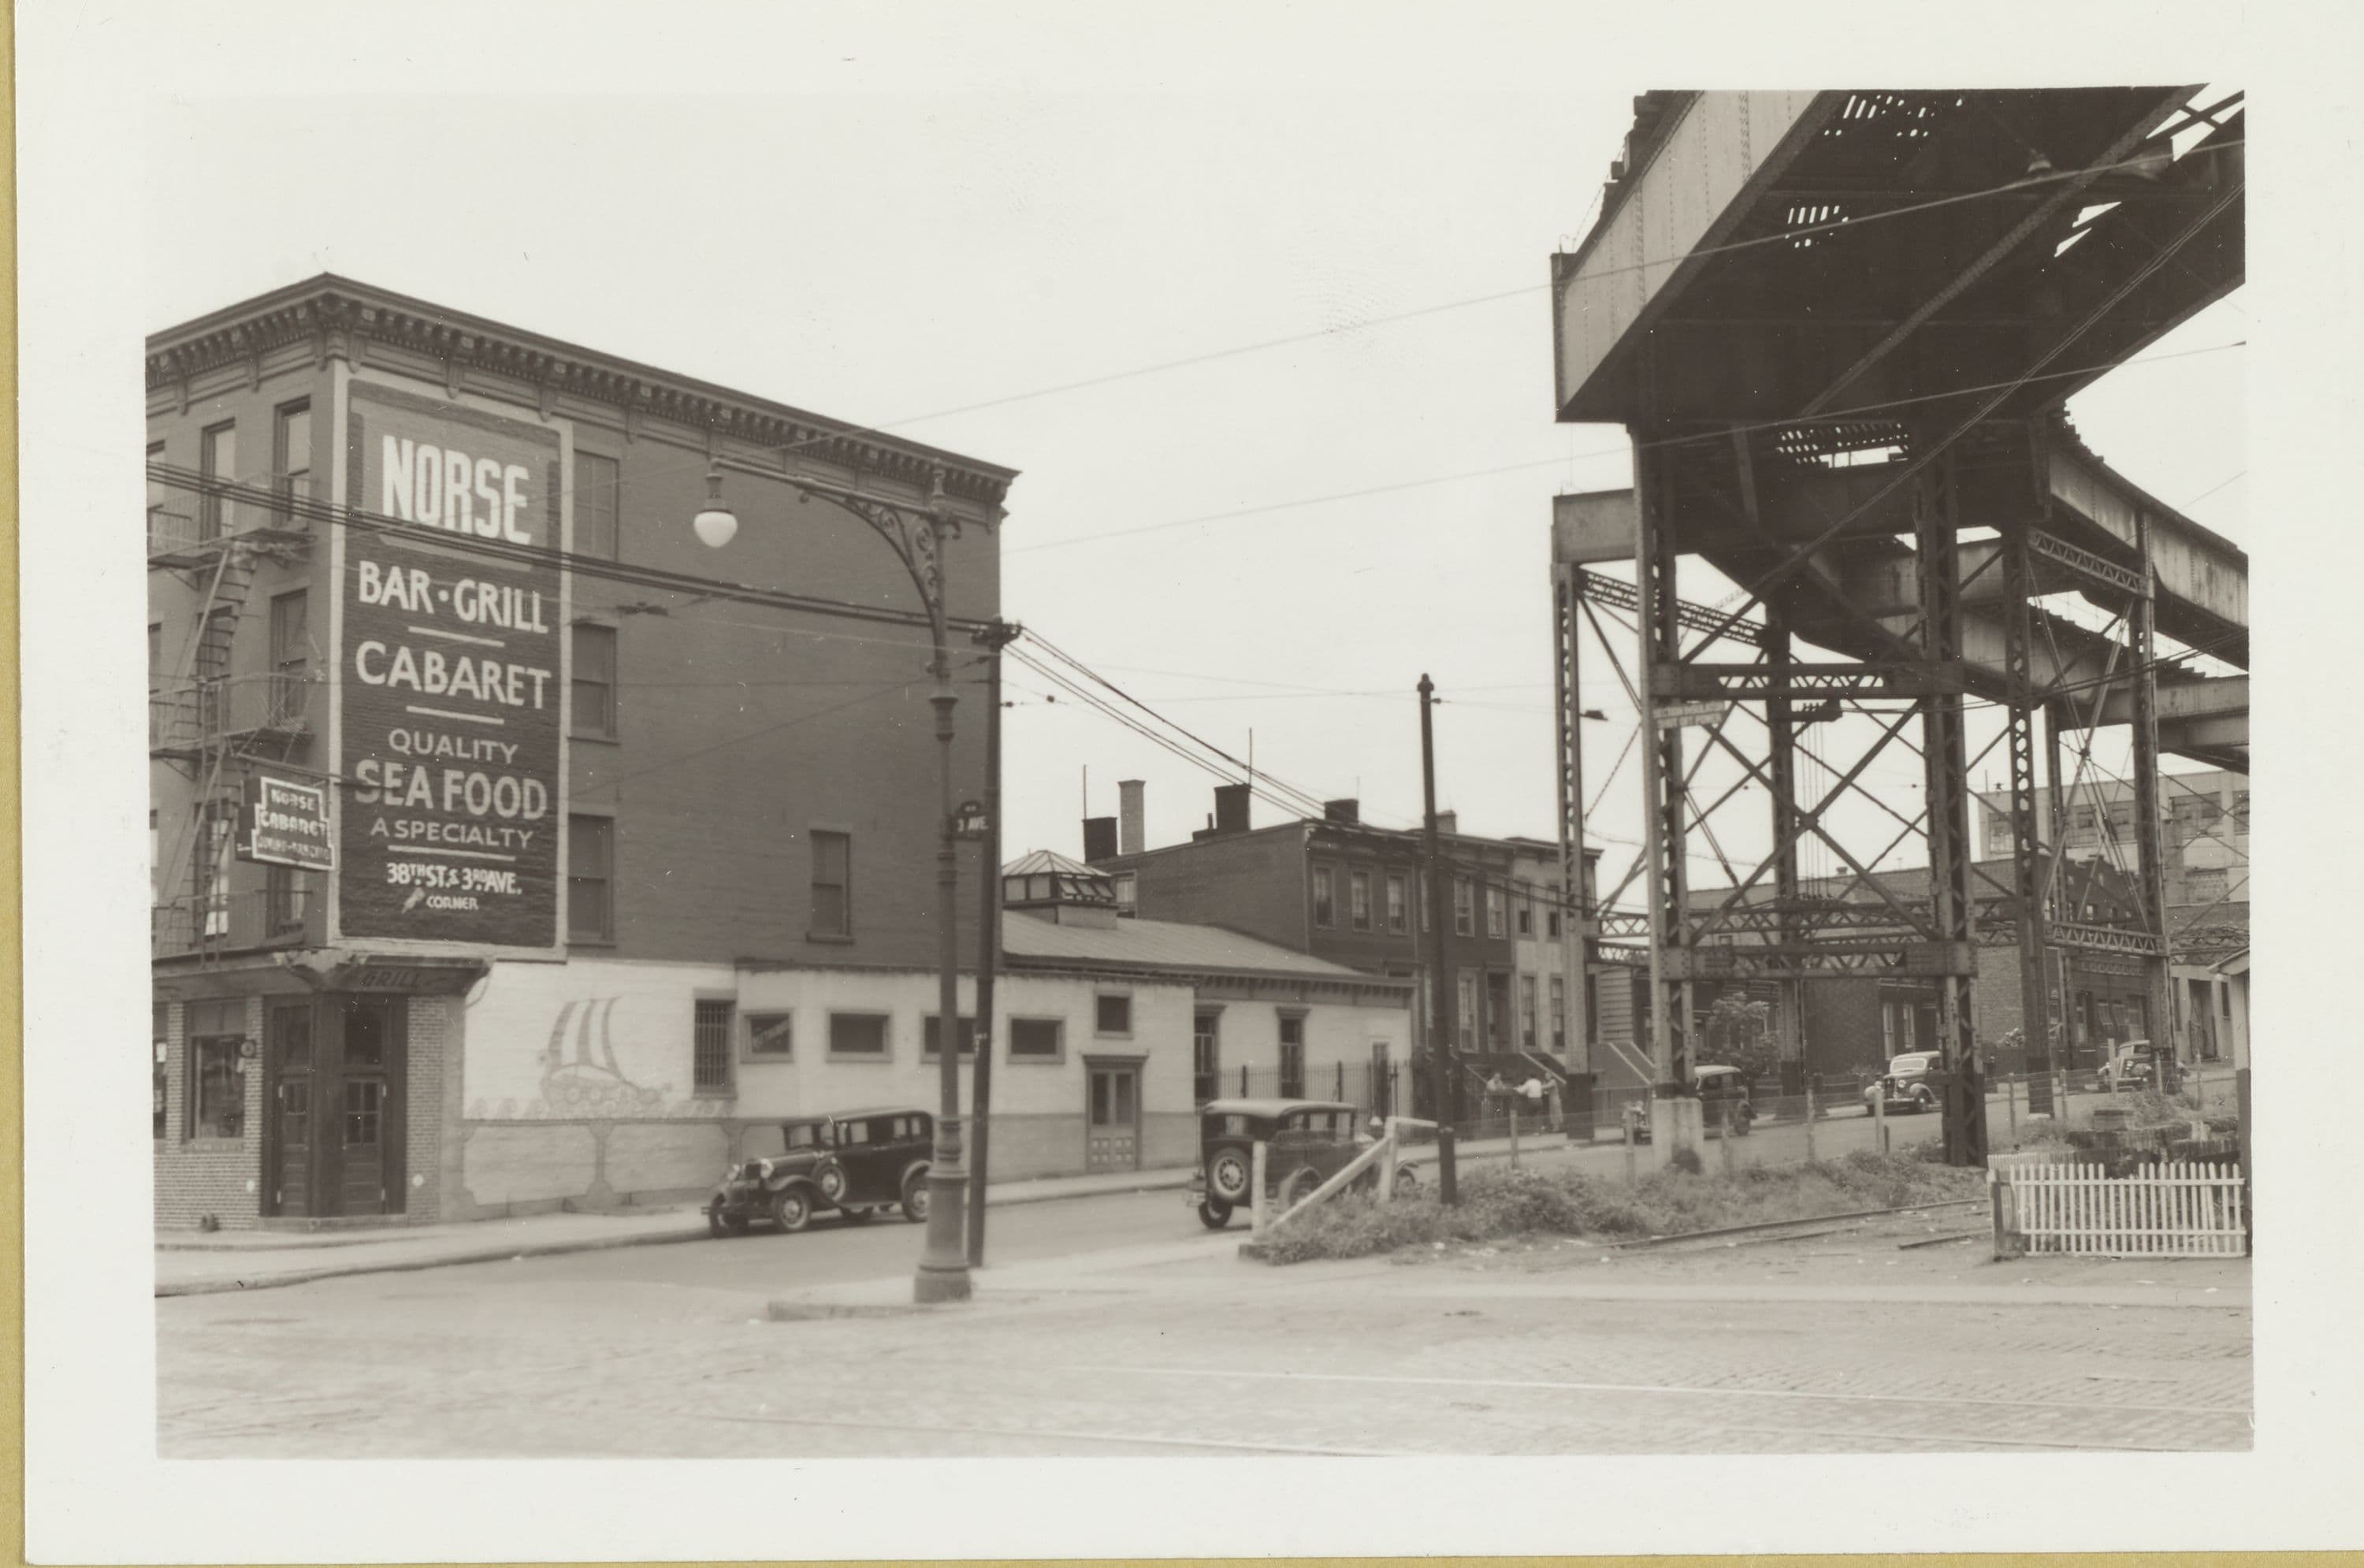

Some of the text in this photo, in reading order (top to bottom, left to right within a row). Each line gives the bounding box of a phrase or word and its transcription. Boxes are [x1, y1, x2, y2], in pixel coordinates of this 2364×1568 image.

[382, 434, 532, 545] NORSE
[359, 559, 549, 634] BAR GRILL
[355, 641, 552, 709] CABARET
[388, 728, 519, 764] QUALITY
[270, 788, 315, 812] NORSE
[355, 759, 548, 820] SEA FOOD
[259, 810, 327, 837] CABARET
[370, 816, 534, 850] A SPECIALTY
[483, 870, 523, 895] AVE.
[426, 894, 480, 911] CORNER
